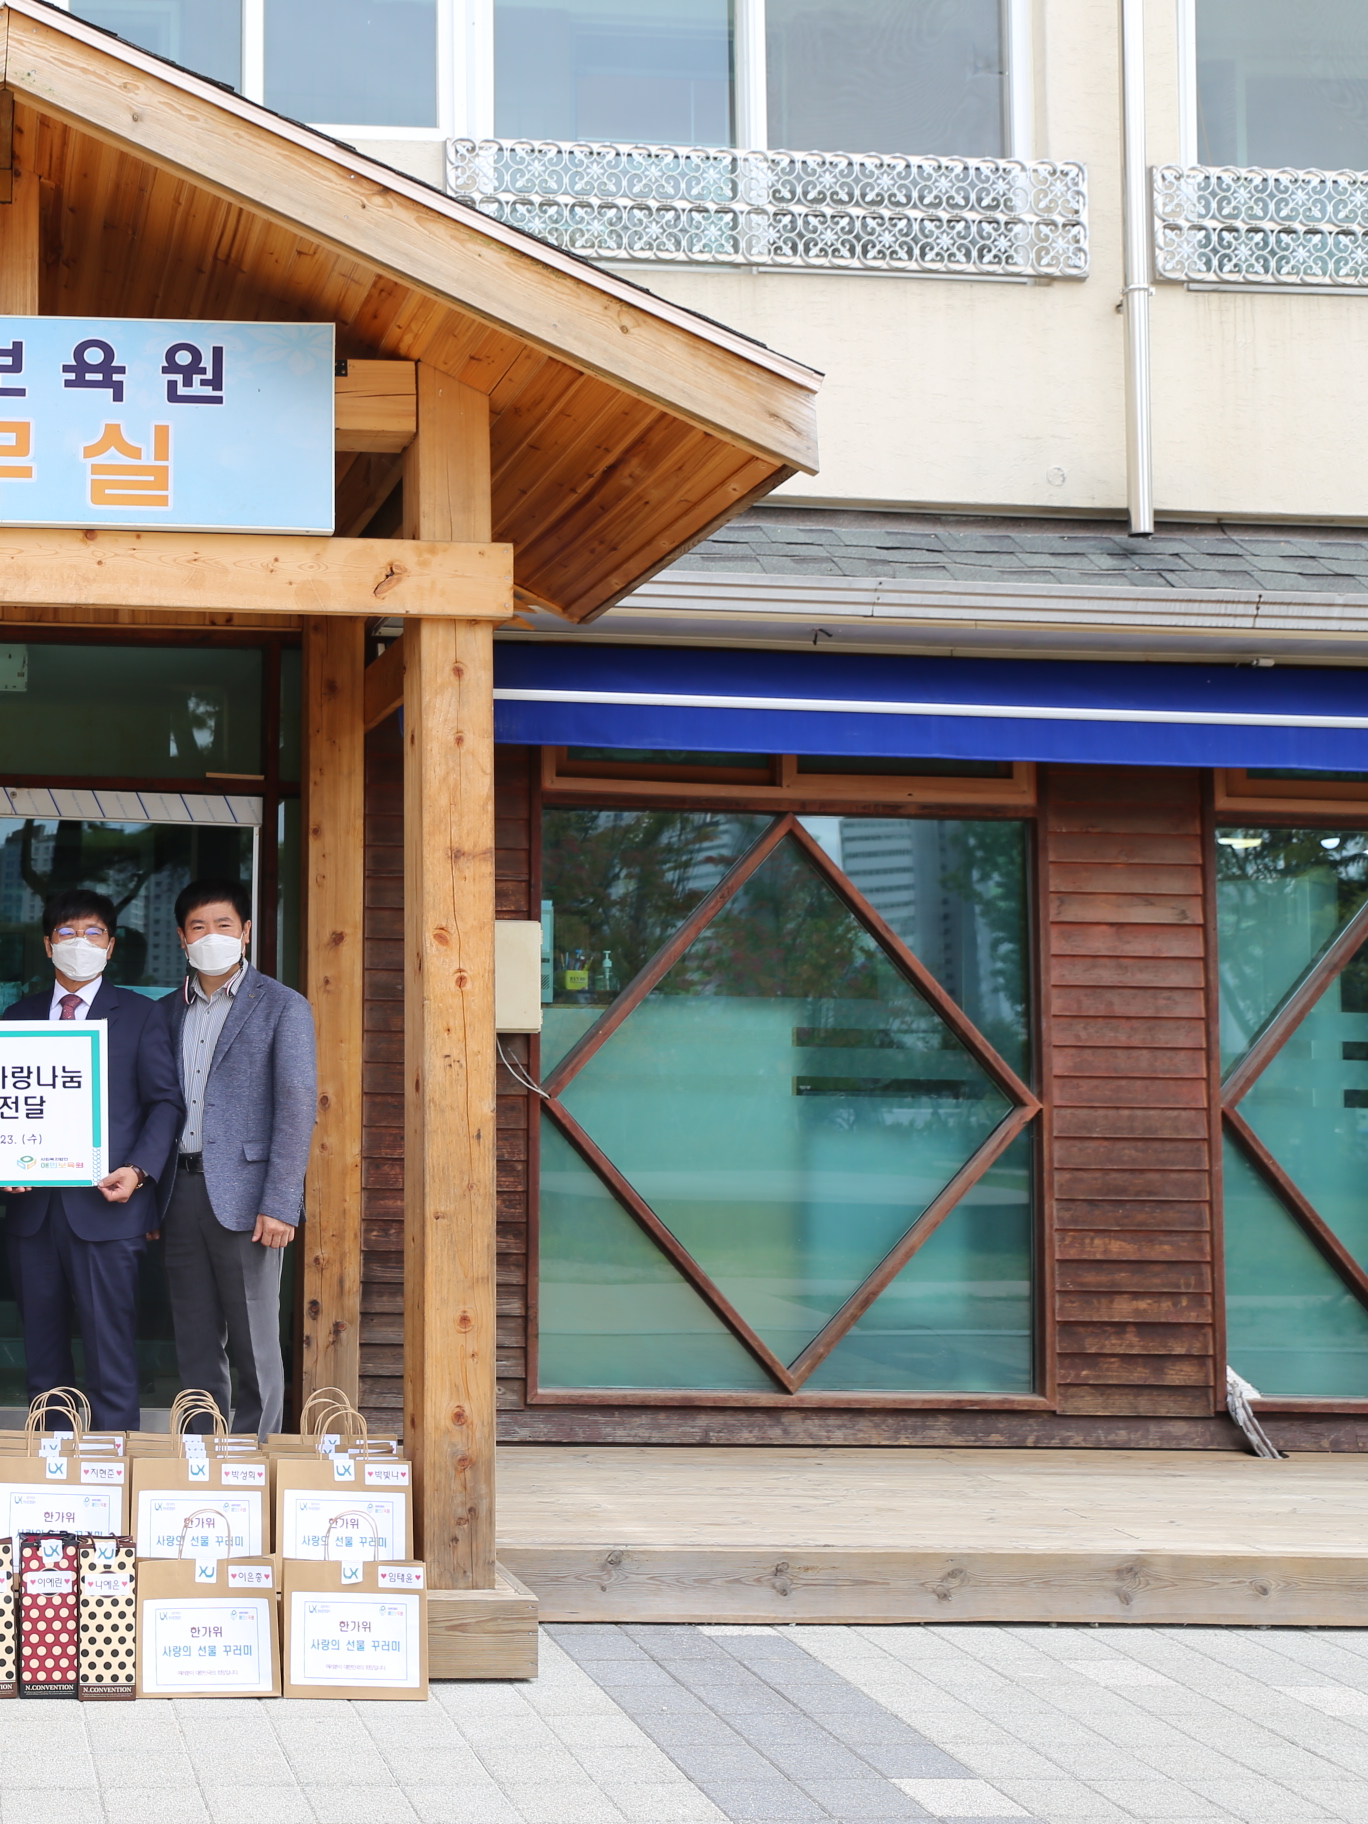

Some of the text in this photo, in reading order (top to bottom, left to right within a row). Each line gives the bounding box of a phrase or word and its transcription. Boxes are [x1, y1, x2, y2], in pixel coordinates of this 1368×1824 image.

[0, 1135, 17, 1145] 23.
[22, 1134, 42, 1146] (수)
[90, 1469, 114, 1478] 지현준
[44, 1512, 76, 1523] 한가위
[184, 1518, 215, 1528] 한가위
[328, 1518, 359, 1529] 한가위
[190, 1536, 209, 1547] 선물
[335, 1536, 353, 1548] 선물
[190, 1626, 222, 1638] 한가위
[339, 1621, 372, 1632] 한가위
[162, 1645, 252, 1657] 사랑의 선물 꾸러미
[310, 1639, 400, 1652] 사랑의 선물 꾸러미
